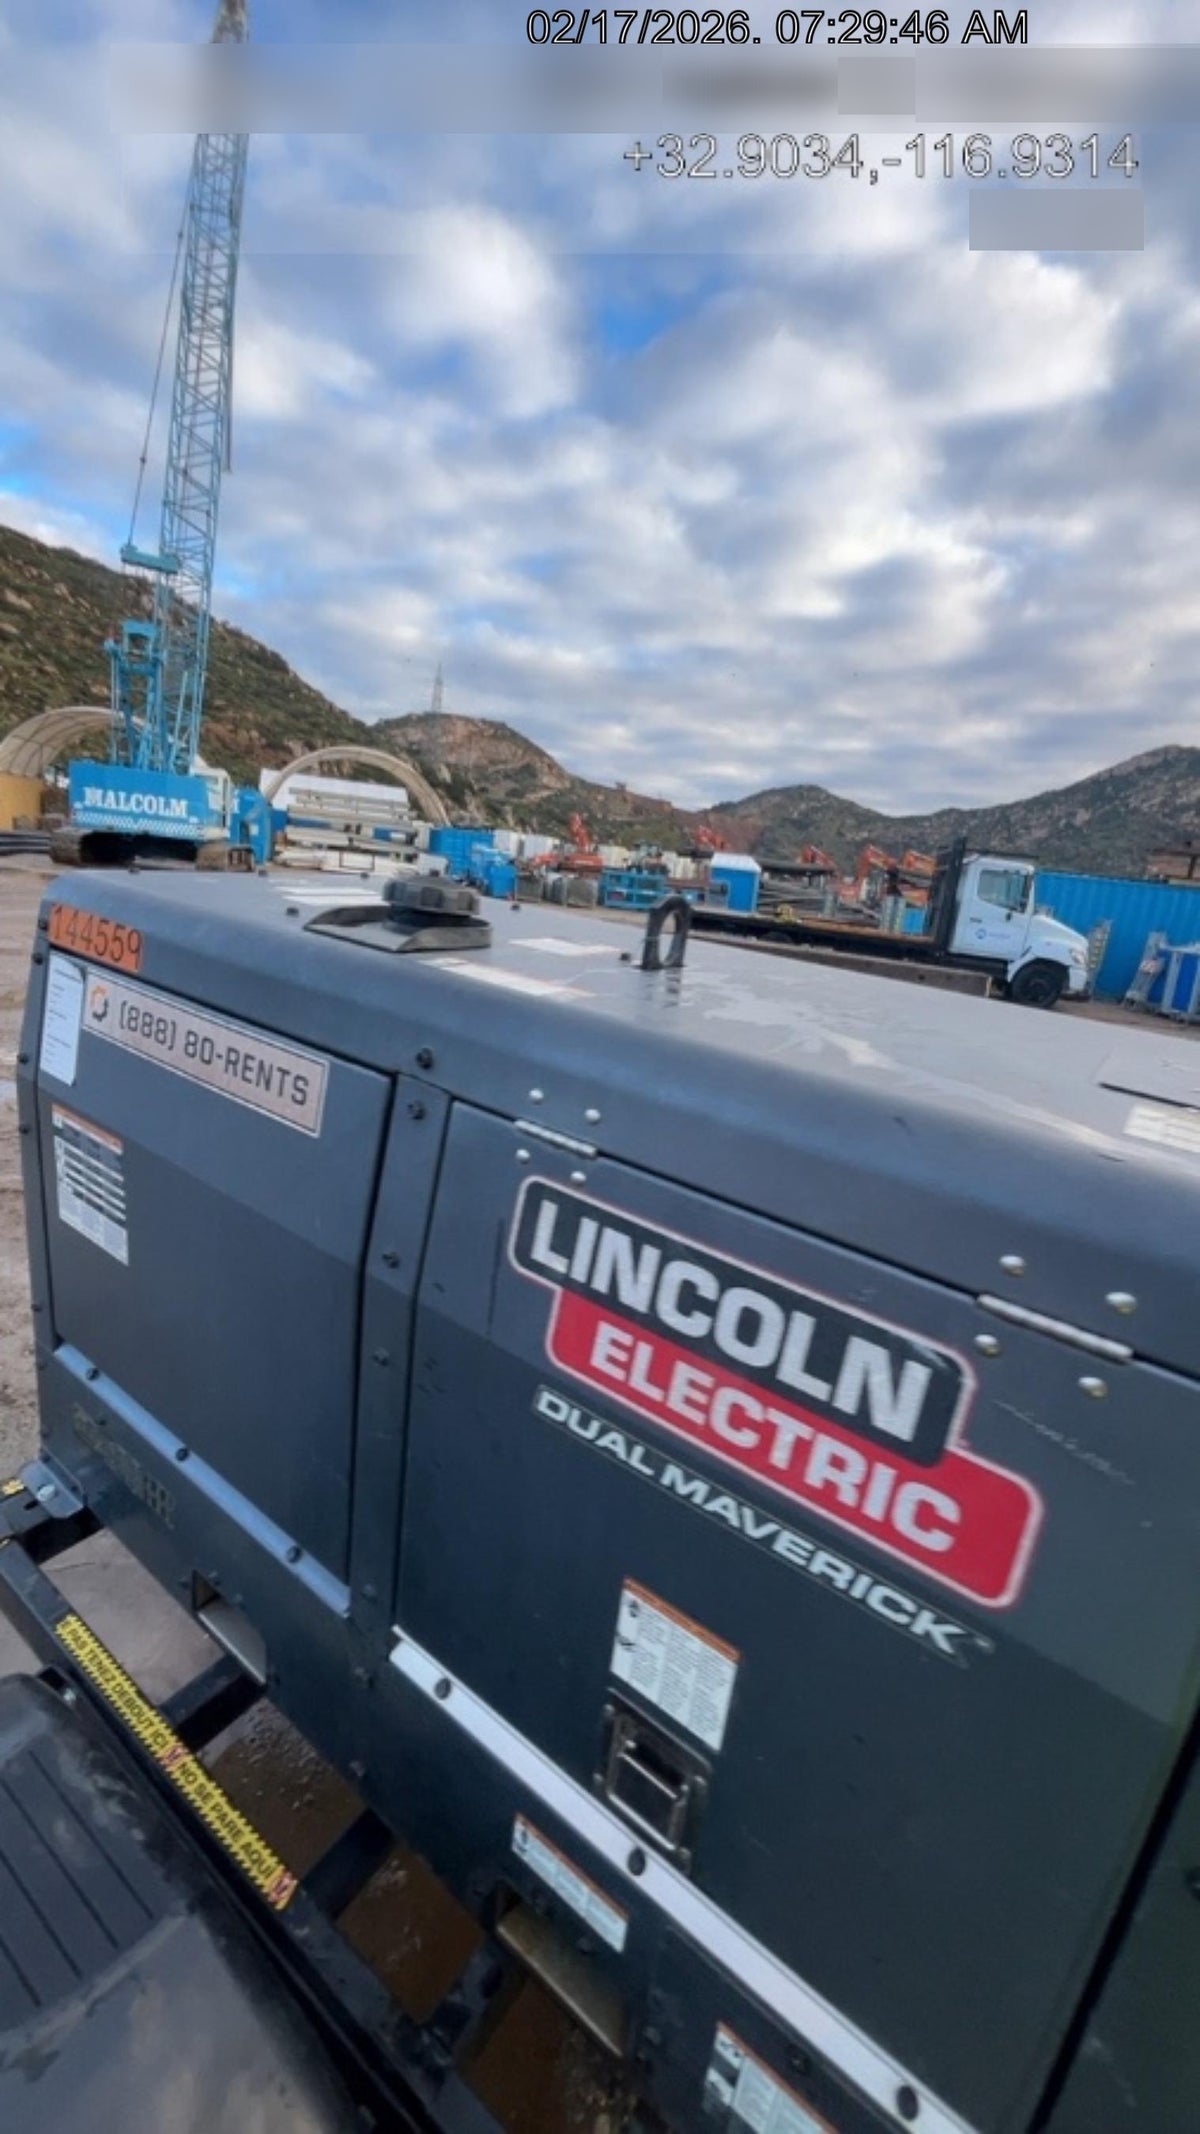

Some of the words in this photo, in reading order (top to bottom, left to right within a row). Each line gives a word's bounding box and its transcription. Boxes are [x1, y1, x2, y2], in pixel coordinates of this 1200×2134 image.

[83, 787, 188, 818] MALCOLM
[54, 905, 142, 971] 144559
[119, 1000, 177, 1051] (888)
[184, 1030, 309, 1106] 80-RENTS
[529, 1200, 933, 1442] LINCOLN
[590, 1320, 962, 1553] ELECTRIC
[537, 1391, 654, 1476] DUAL
[660, 1464, 967, 1654] MAVERICK
[176, 1761, 198, 1786] NO
[208, 1800, 245, 1843] PARE
